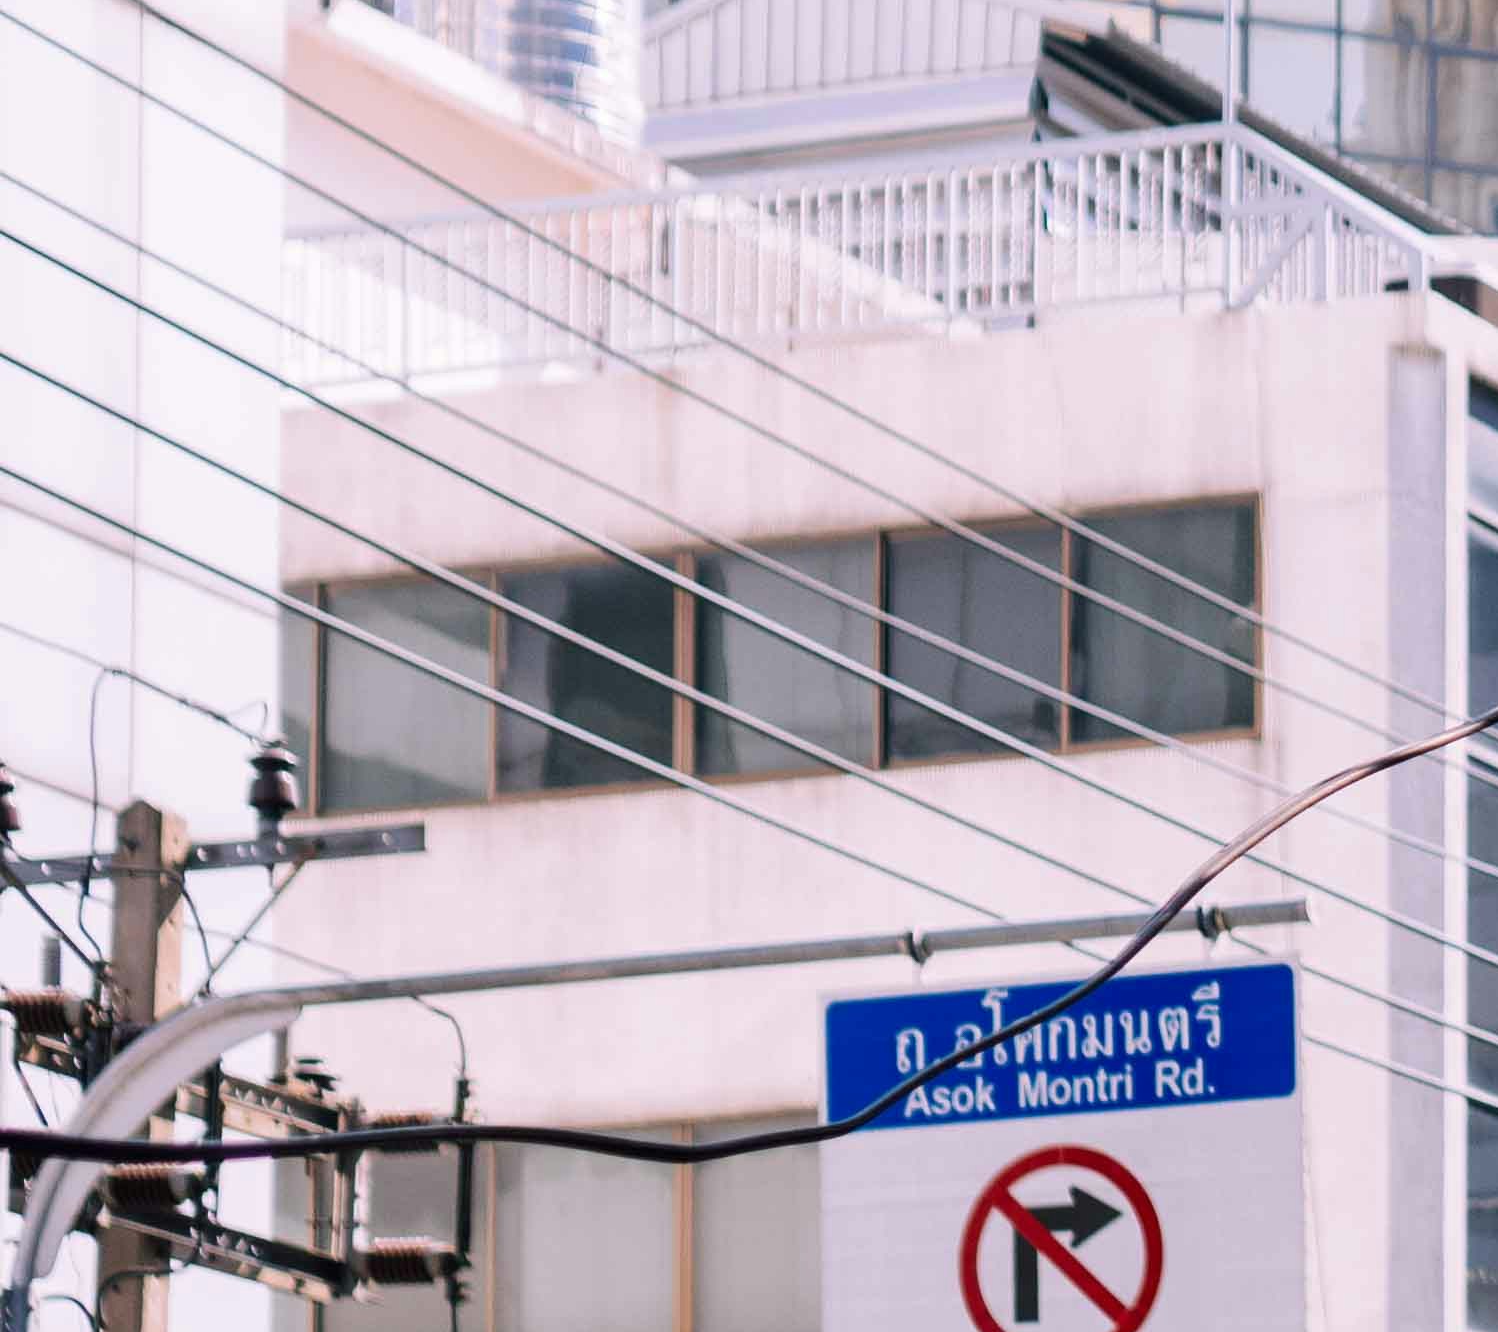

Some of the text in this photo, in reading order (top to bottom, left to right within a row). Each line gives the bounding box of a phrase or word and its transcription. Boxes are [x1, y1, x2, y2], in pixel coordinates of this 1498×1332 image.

[904, 1059, 1217, 1118] Asok Montri Rd.
